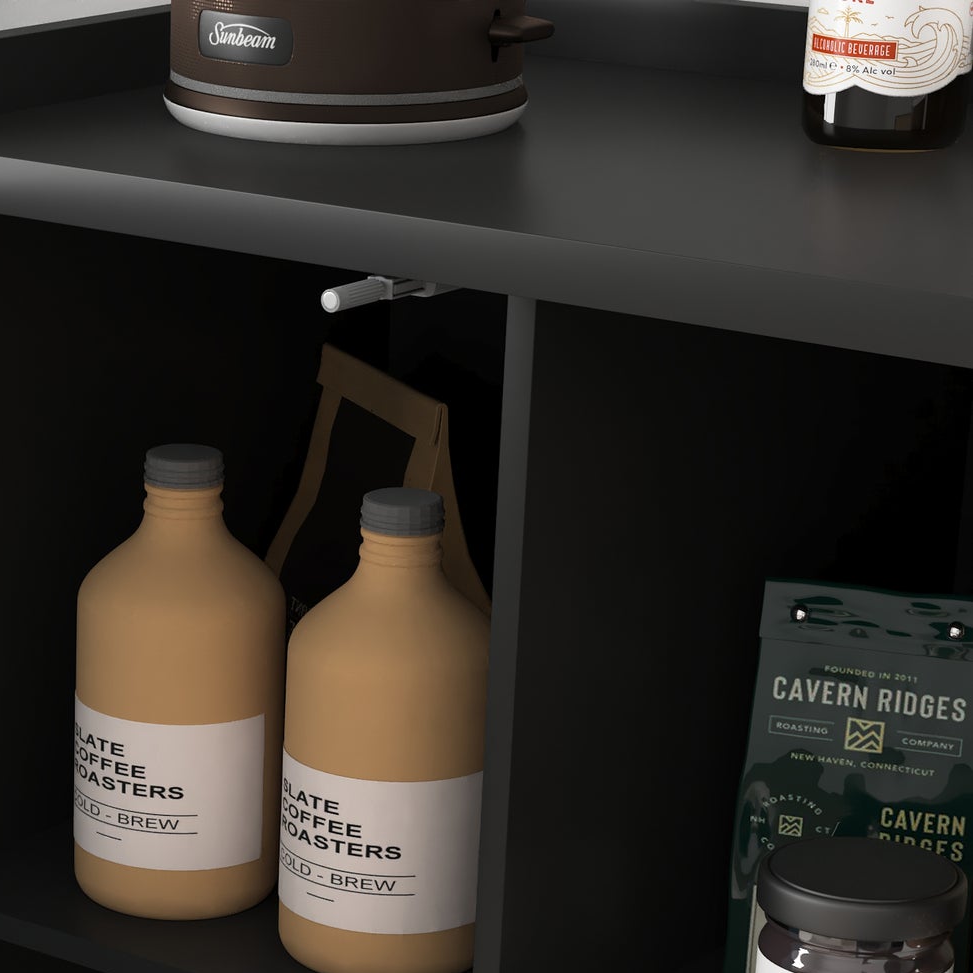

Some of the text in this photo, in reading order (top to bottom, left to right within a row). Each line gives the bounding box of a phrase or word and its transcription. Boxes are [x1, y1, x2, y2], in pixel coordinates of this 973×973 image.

[209, 21, 276, 49] Sunbeam
[814, 37, 891, 57] ALCOHOLIC BEVERAGE
[846, 65, 859, 73] 8%
[862, 66, 878, 75] Alc
[825, 665, 918, 683] FOUNDED IN 2011
[773, 676, 967, 722] CAVERN RIDGES
[776, 721, 828, 735] ROASTING
[902, 737, 955, 751] COMPANY
[790, 752, 815, 762] NEW
[860, 761, 936, 777] CONNECTICUT
[283, 778, 340, 815] SLATE
[118, 813, 179, 830] BREW
[282, 797, 362, 838] COFFEE
[880, 807, 966, 837] CAVERN
[282, 815, 402, 860] ROASTERS
[280, 847, 312, 876] COLD
[330, 873, 397, 892] BREW
